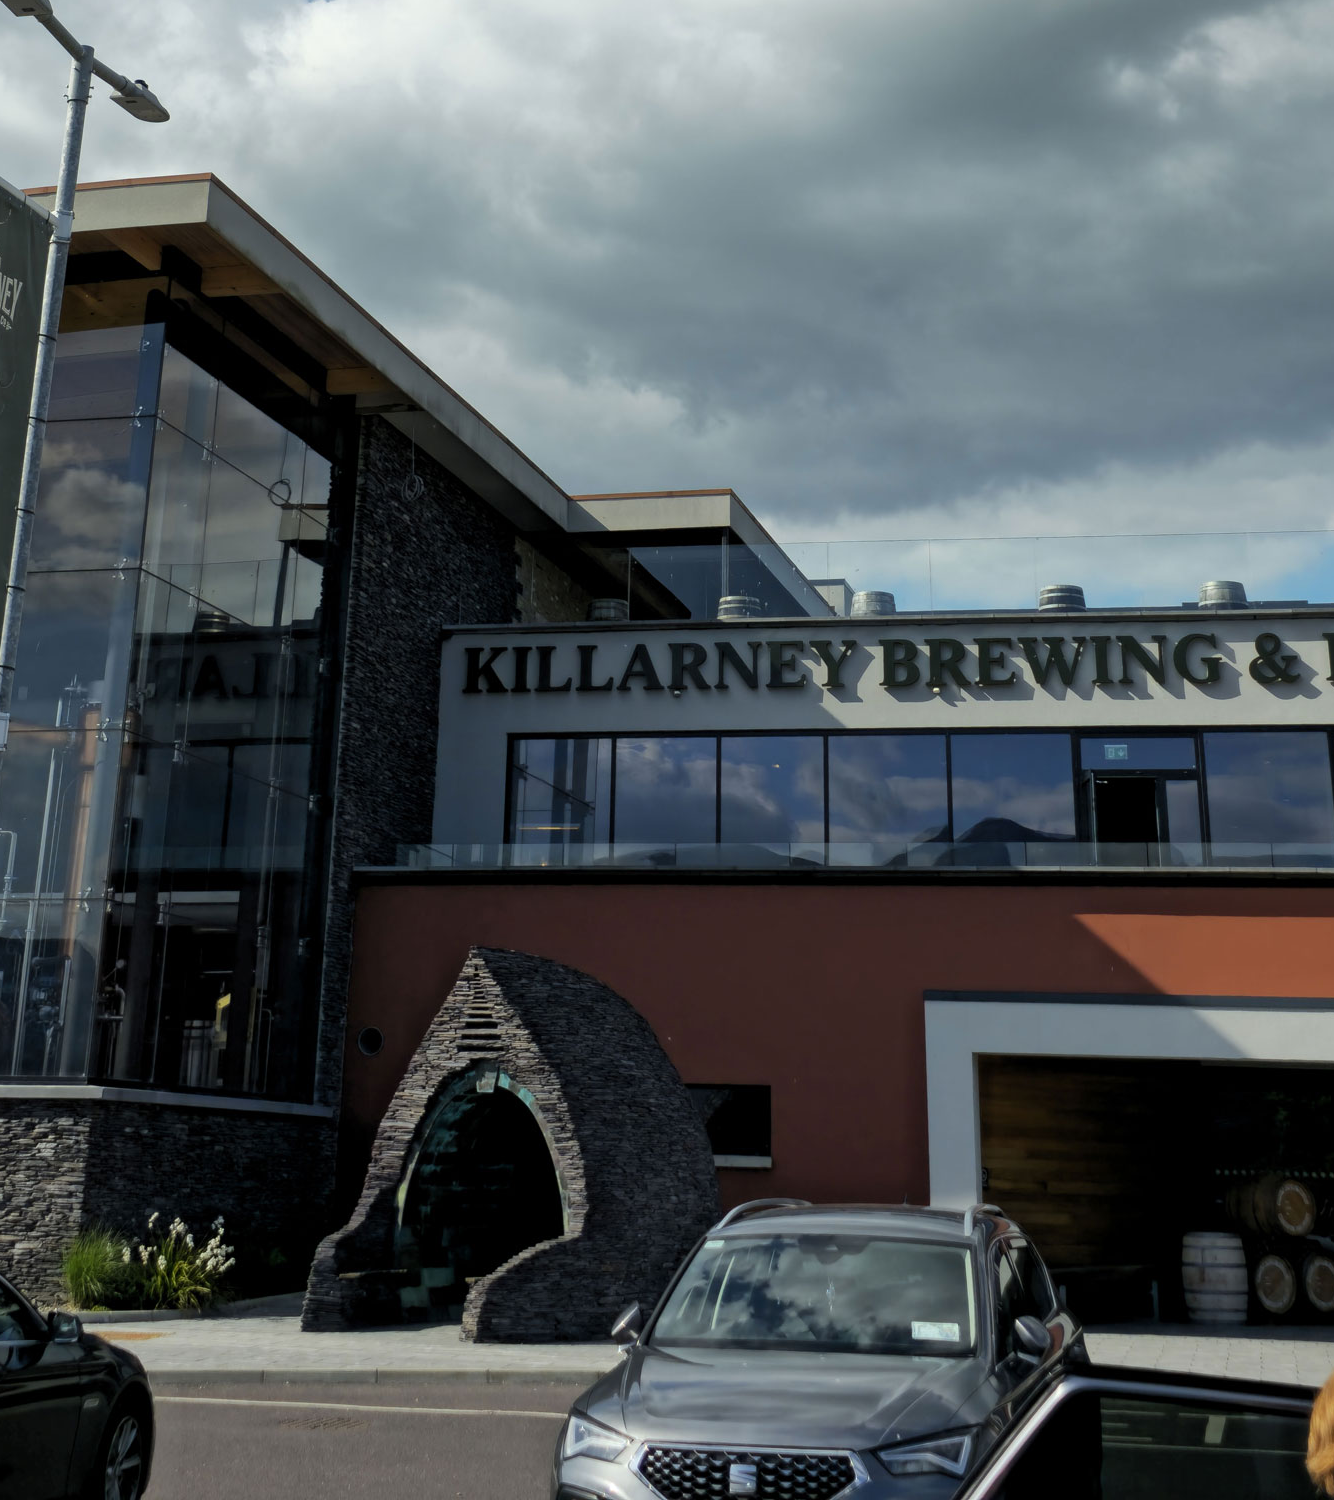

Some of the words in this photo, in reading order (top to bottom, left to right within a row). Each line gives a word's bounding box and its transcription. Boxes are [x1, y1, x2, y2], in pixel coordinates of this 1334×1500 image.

[463, 639, 857, 694] KILLARNEY
[878, 632, 1223, 688] BREWING
[1248, 632, 1301, 684] &
